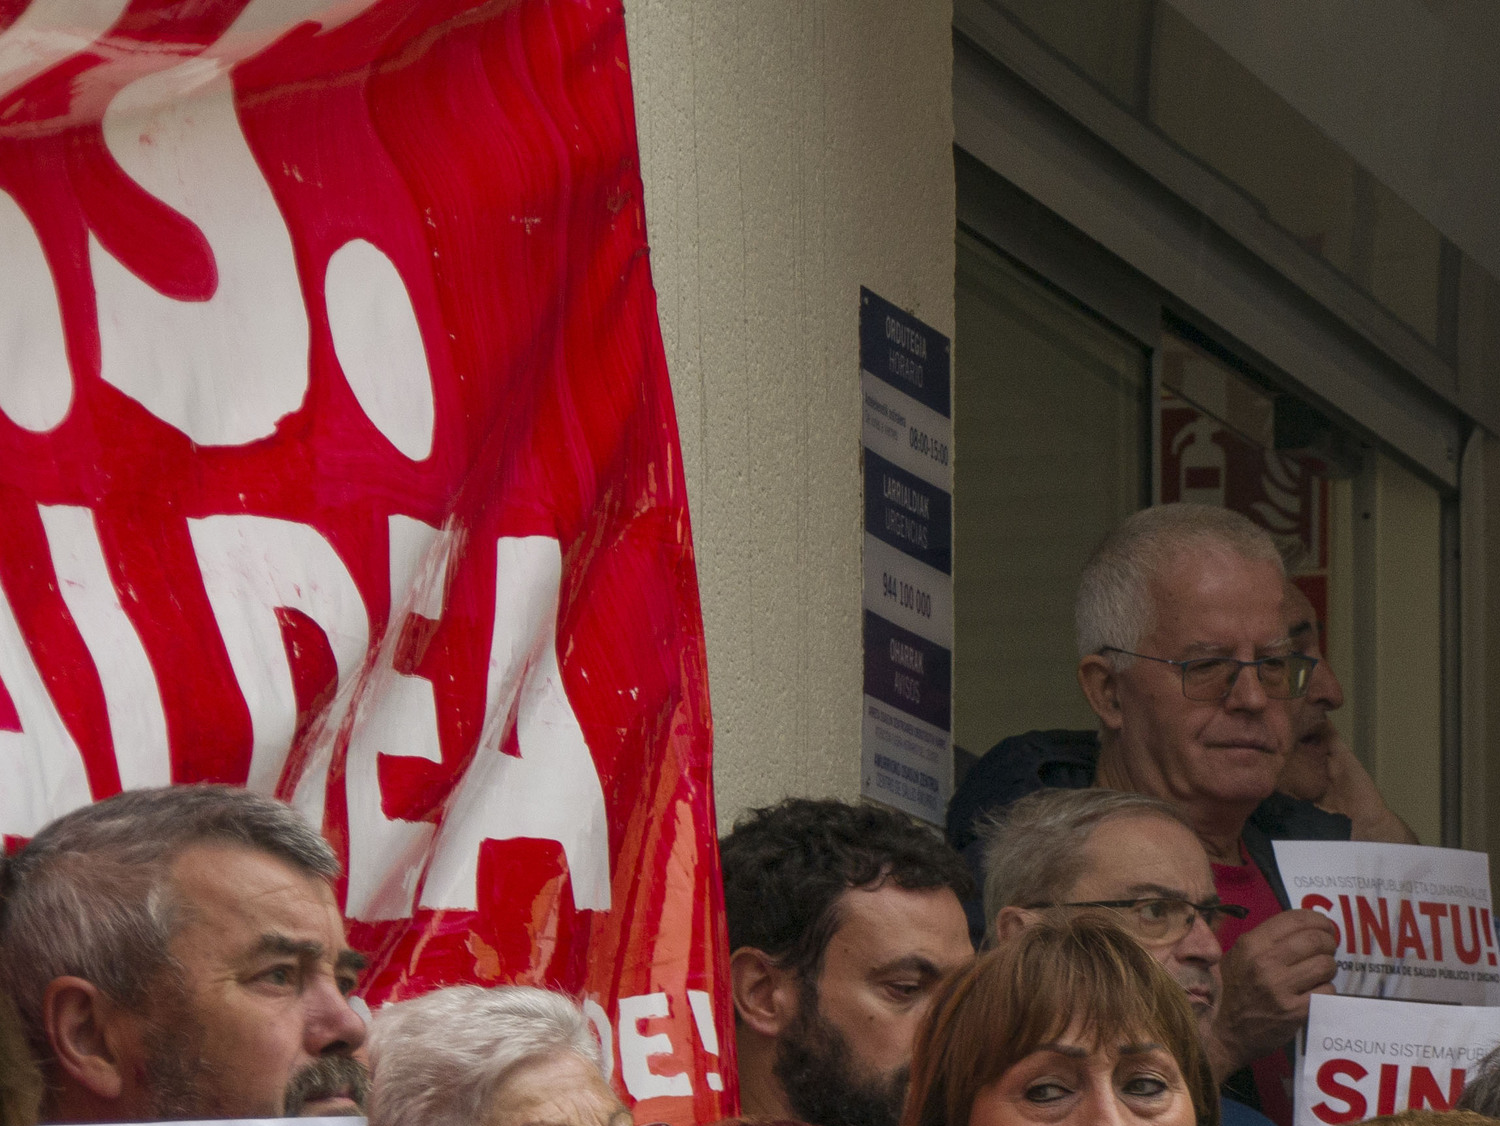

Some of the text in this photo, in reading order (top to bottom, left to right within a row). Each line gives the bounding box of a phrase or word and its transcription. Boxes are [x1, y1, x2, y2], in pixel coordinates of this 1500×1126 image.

[885, 315, 928, 360] ORDUTEGIA
[889, 351, 924, 389] HORARIO
[908, 426, 949, 467] 08:00-15:00
[883, 472, 930, 521] LARRIALDIAK
[885, 507, 929, 550] URGENCIAS
[883, 571, 932, 620] 944 100 000
[1301, 893, 1498, 972] SINATU!
[1322, 1037, 1454, 1060] OSASUN SISTEMA
